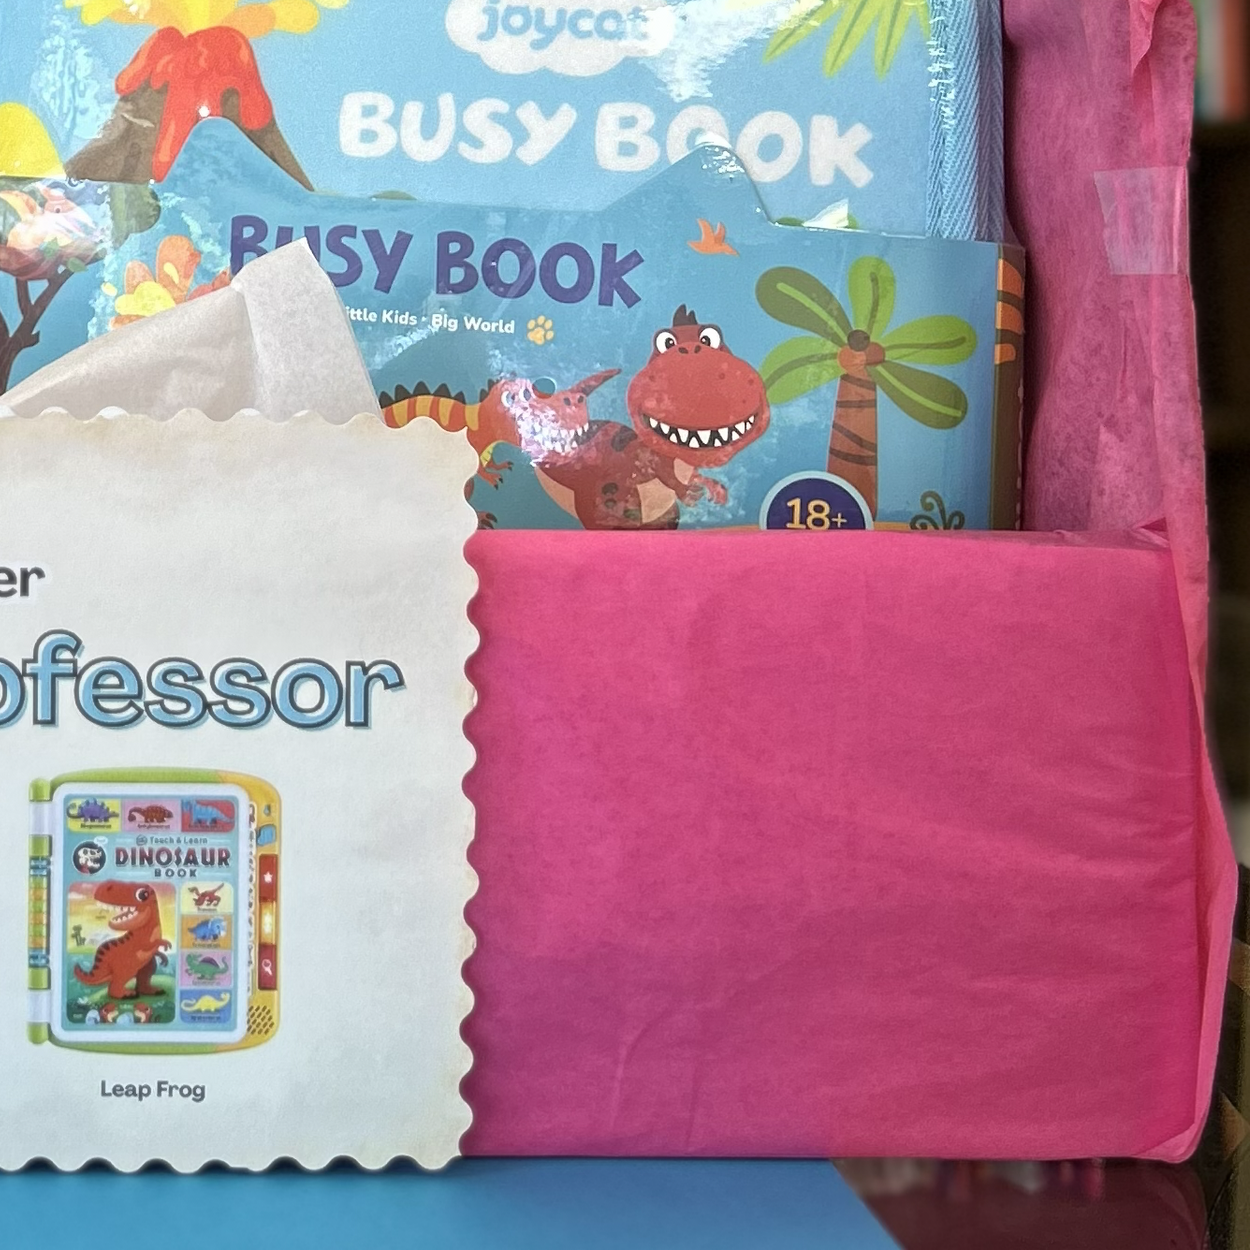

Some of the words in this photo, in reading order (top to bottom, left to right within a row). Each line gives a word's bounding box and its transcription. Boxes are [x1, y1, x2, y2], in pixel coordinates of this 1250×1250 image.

[338, 92, 578, 166] BUSY
[595, 101, 875, 188] BOOK
[435, 231, 645, 309] BOOK
[345, 306, 377, 322] ittle
[381, 309, 417, 326] Kids
[432, 313, 458, 331] Big
[464, 316, 515, 334] World
[786, 498, 847, 530] 18+
[114, 846, 231, 868] DINOSAUR
[154, 868, 198, 878] BOOK
[100, 1080, 152, 1102] Leap
[157, 1080, 206, 1102] Frog
